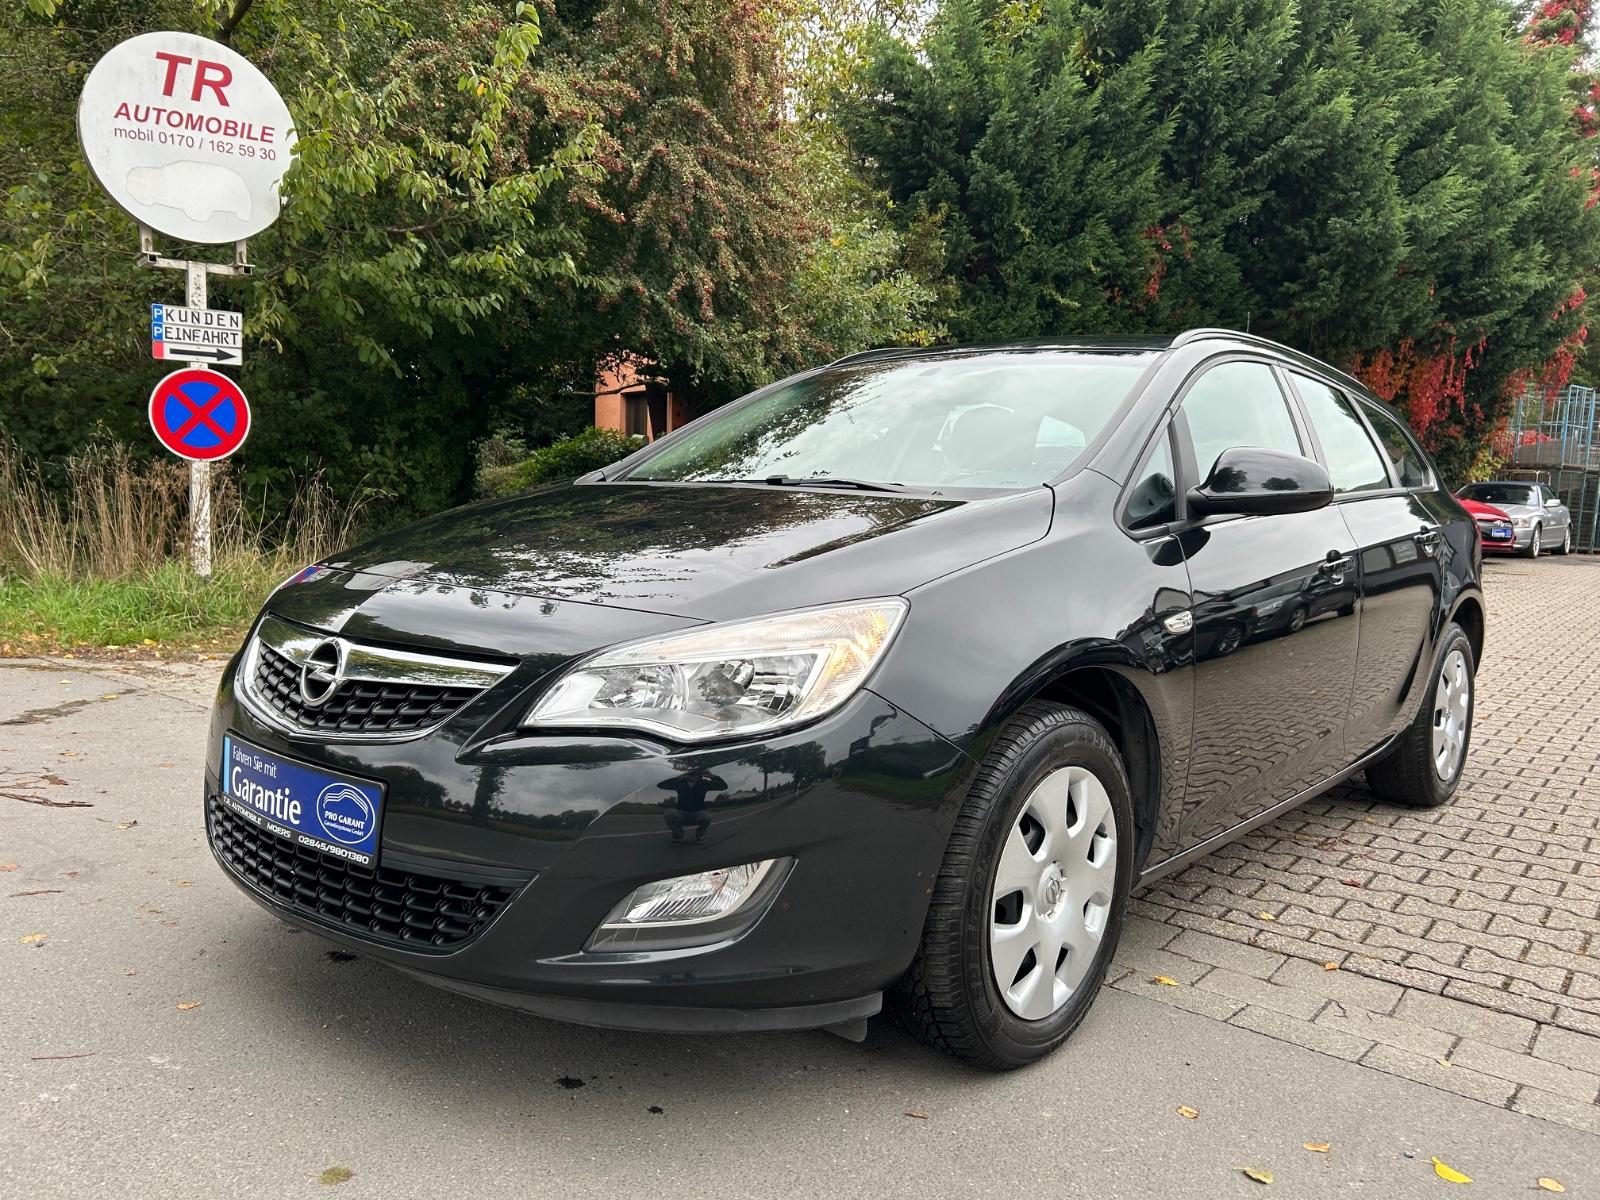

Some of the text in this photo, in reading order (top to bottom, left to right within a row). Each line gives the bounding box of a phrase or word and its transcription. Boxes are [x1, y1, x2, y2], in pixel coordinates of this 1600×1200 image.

[156, 51, 233, 107] TR
[114, 102, 275, 143] AUTOMOBILE
[114, 126, 154, 142] mobil
[158, 131, 195, 149] 0170
[208, 140, 234, 155] 162
[238, 144, 255, 158] 59
[259, 148, 276, 161] 30
[164, 326, 239, 345] EINFAHRT
[165, 308, 239, 328] KUNDEN
[232, 745, 277, 778] Fahren Sie mit
[232, 766, 301, 825] Garantie
[231, 801, 262, 825] AUTOMOBILE
[266, 822, 292, 838] MOERS
[298, 835, 369, 865] 02845/9801380
[324, 810, 365, 830] PRO GARANT
